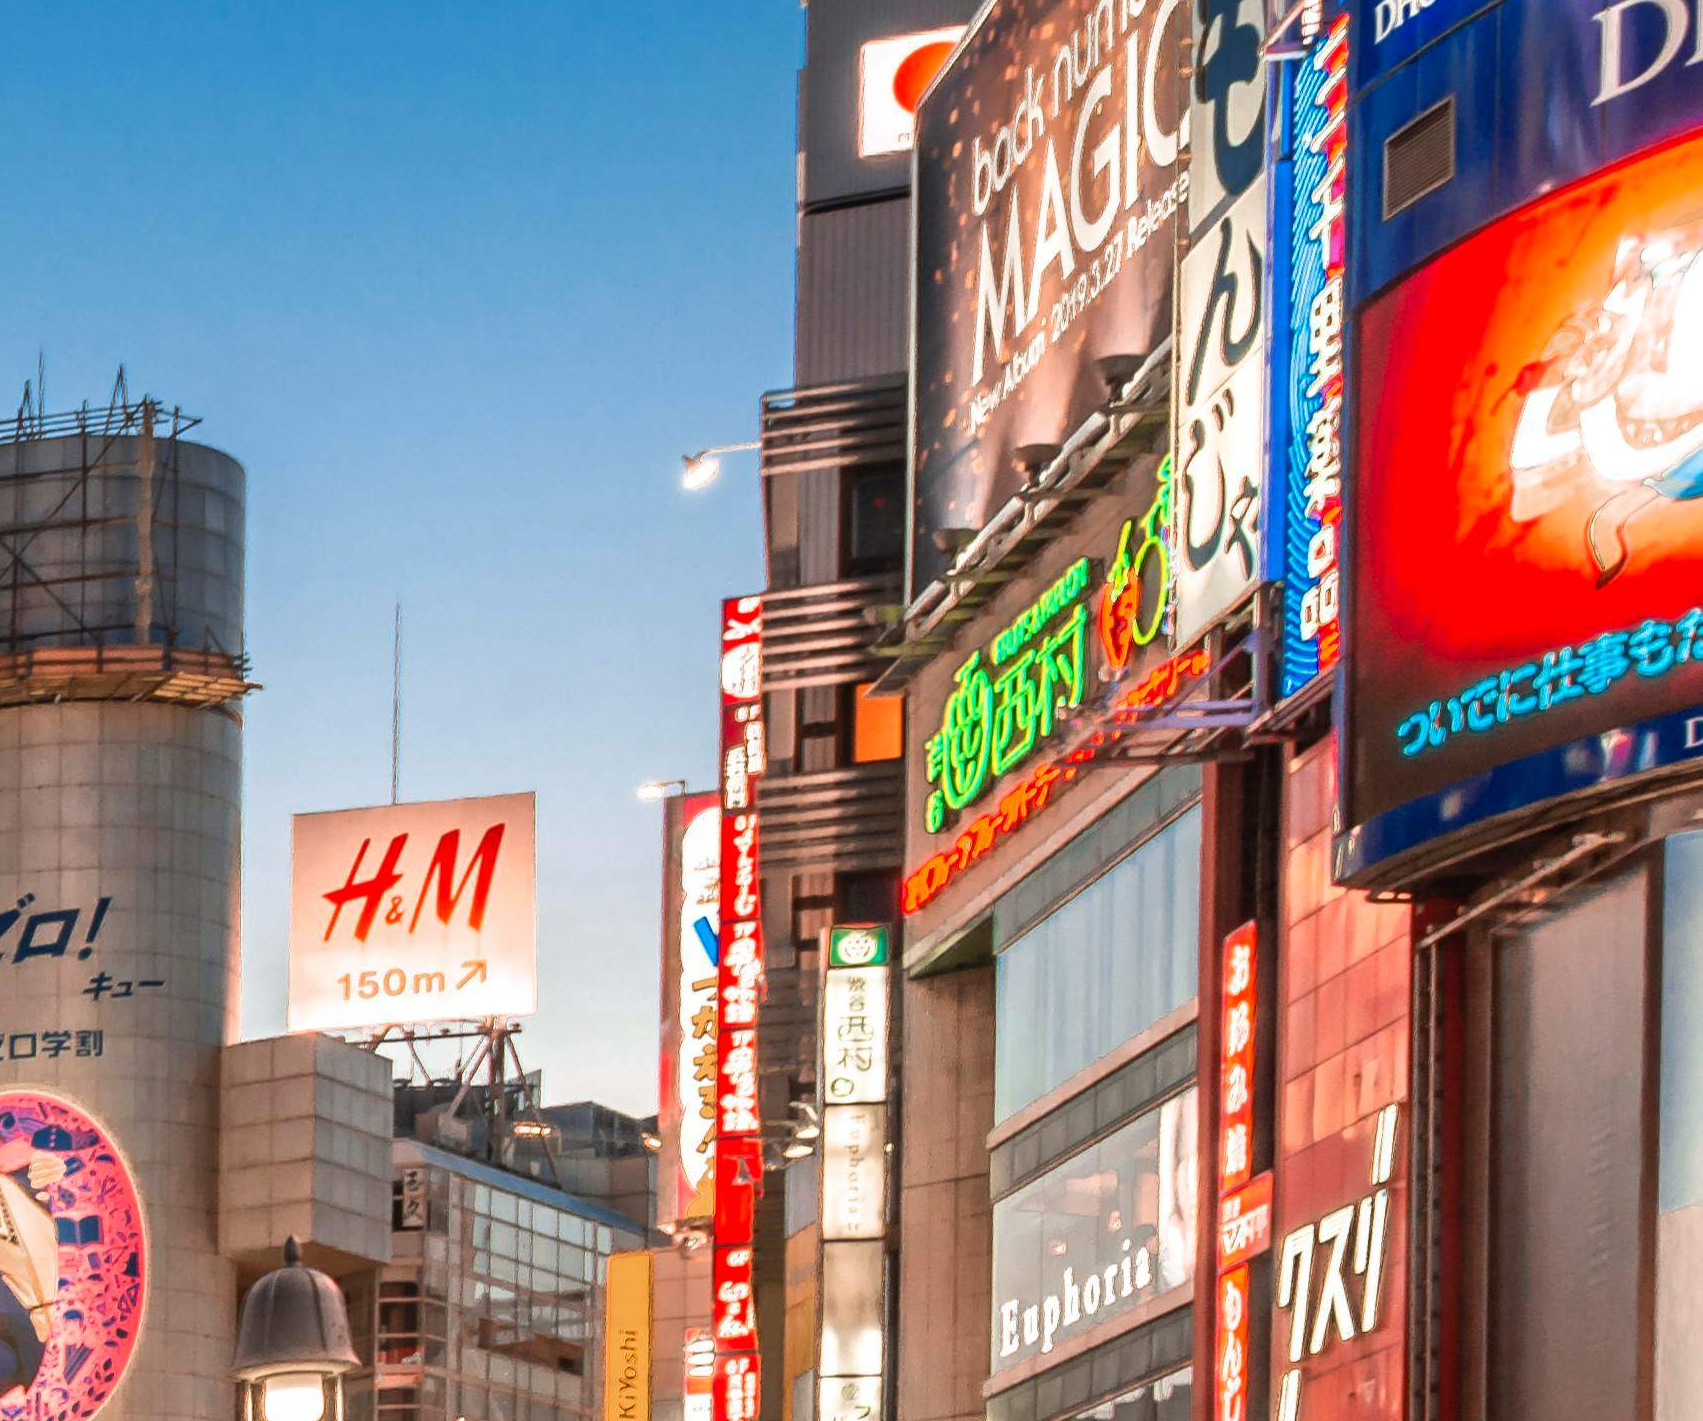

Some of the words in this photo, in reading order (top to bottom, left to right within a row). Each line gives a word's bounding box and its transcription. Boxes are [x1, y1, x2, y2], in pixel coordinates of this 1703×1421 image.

[973, 65, 1045, 217] back
[322, 822, 507, 944] H&M
[82, 970, 166, 1001] キュー
[338, 966, 447, 1004] 150m
[999, 1235, 1153, 1357] Euphoria
[1277, 1186, 1389, 1365] クスリ
